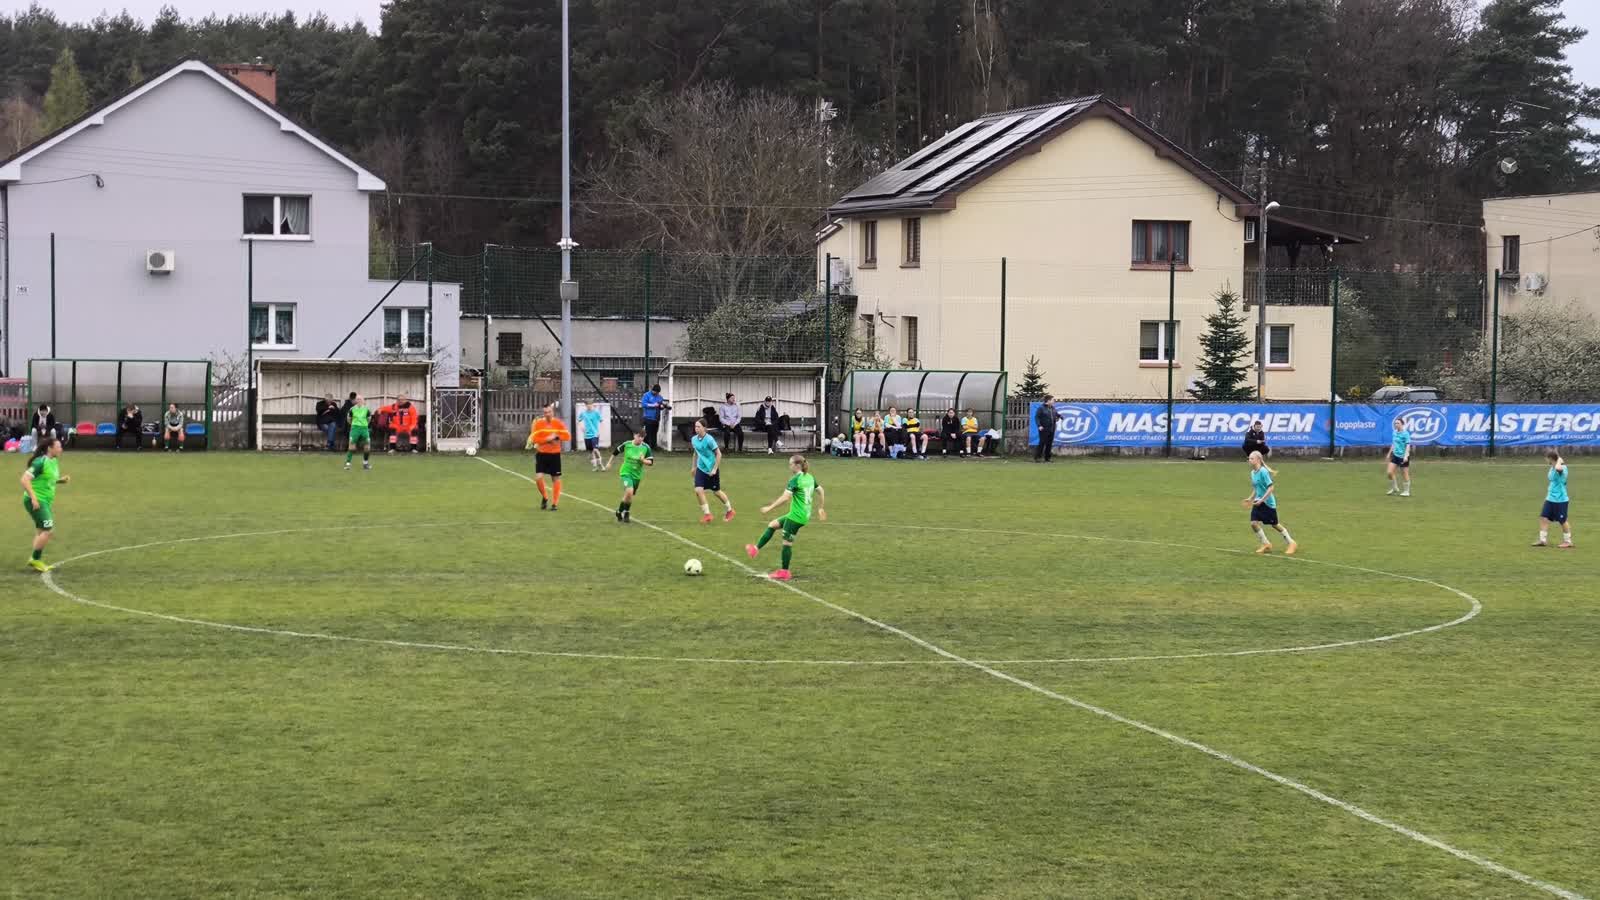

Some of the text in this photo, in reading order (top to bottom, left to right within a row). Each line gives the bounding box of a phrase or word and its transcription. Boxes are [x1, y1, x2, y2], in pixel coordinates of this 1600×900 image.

[1107, 412, 1316, 433] MASTERCHEM
[1335, 420, 1376, 431] Logoplaste
[1402, 417, 1440, 432] MCH
